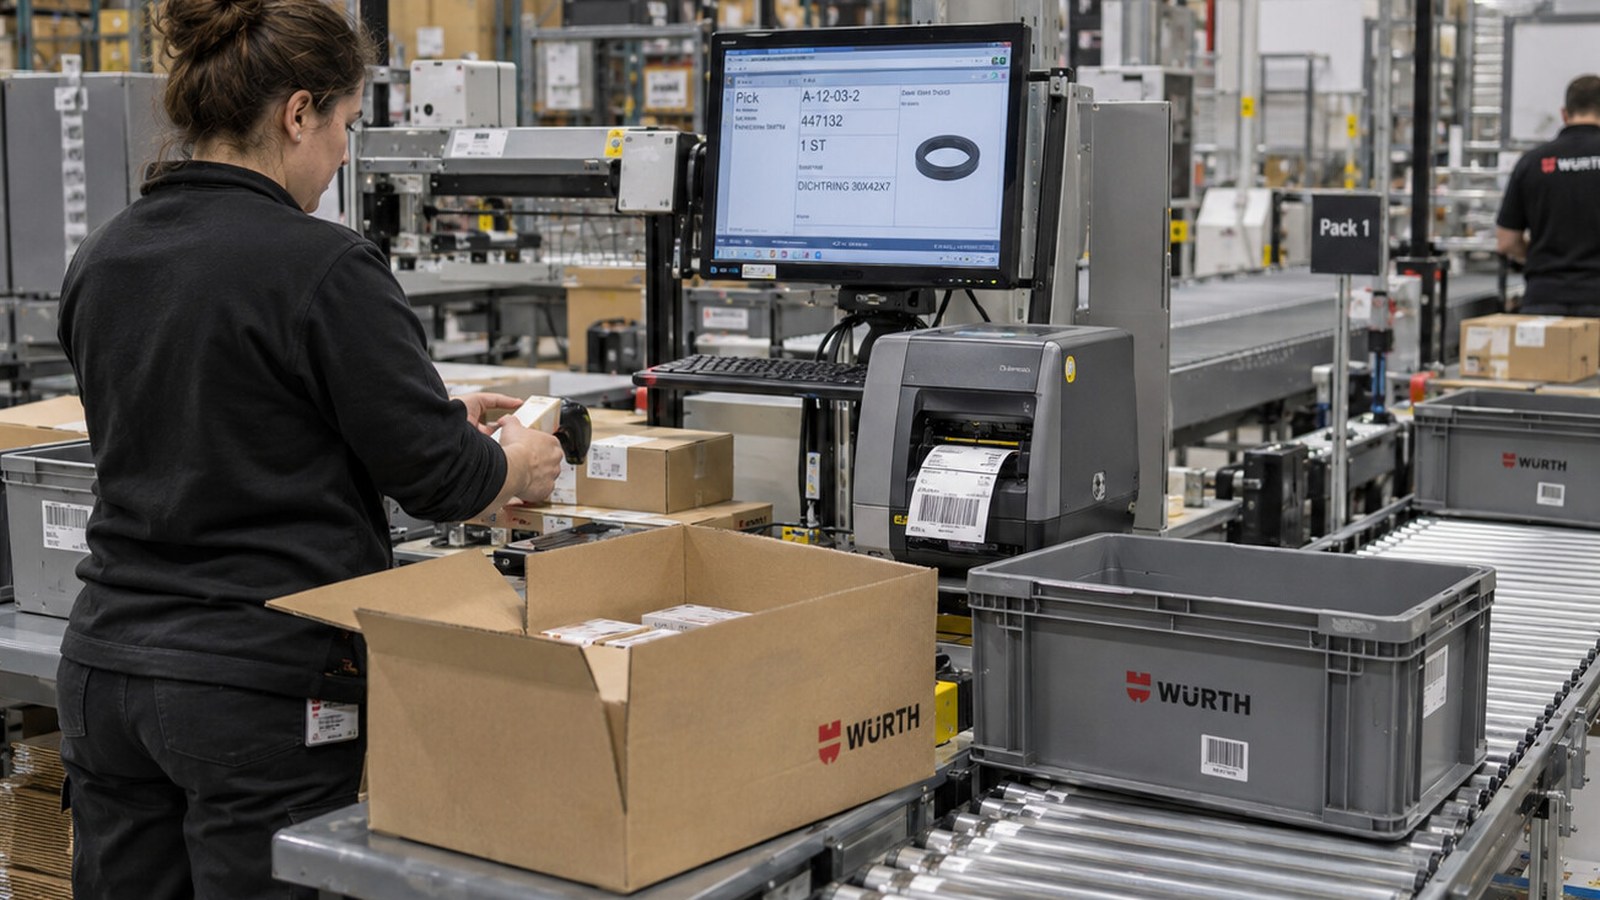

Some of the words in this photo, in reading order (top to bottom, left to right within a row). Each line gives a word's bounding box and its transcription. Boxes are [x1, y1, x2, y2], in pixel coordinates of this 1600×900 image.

[736, 91, 759, 104] Pick
[802, 89, 861, 103] A-12-03-2
[801, 114, 843, 128] 447132
[801, 139, 806, 152] 1
[810, 139, 827, 152] ST
[797, 181, 850, 191] DICHTRING
[851, 181, 891, 192] 30X42X7
[1320, 217, 1358, 237] Pack
[1362, 219, 1370, 237] 1
[1157, 680, 1251, 716] WÜRTH
[846, 703, 920, 751] WÜRTH
